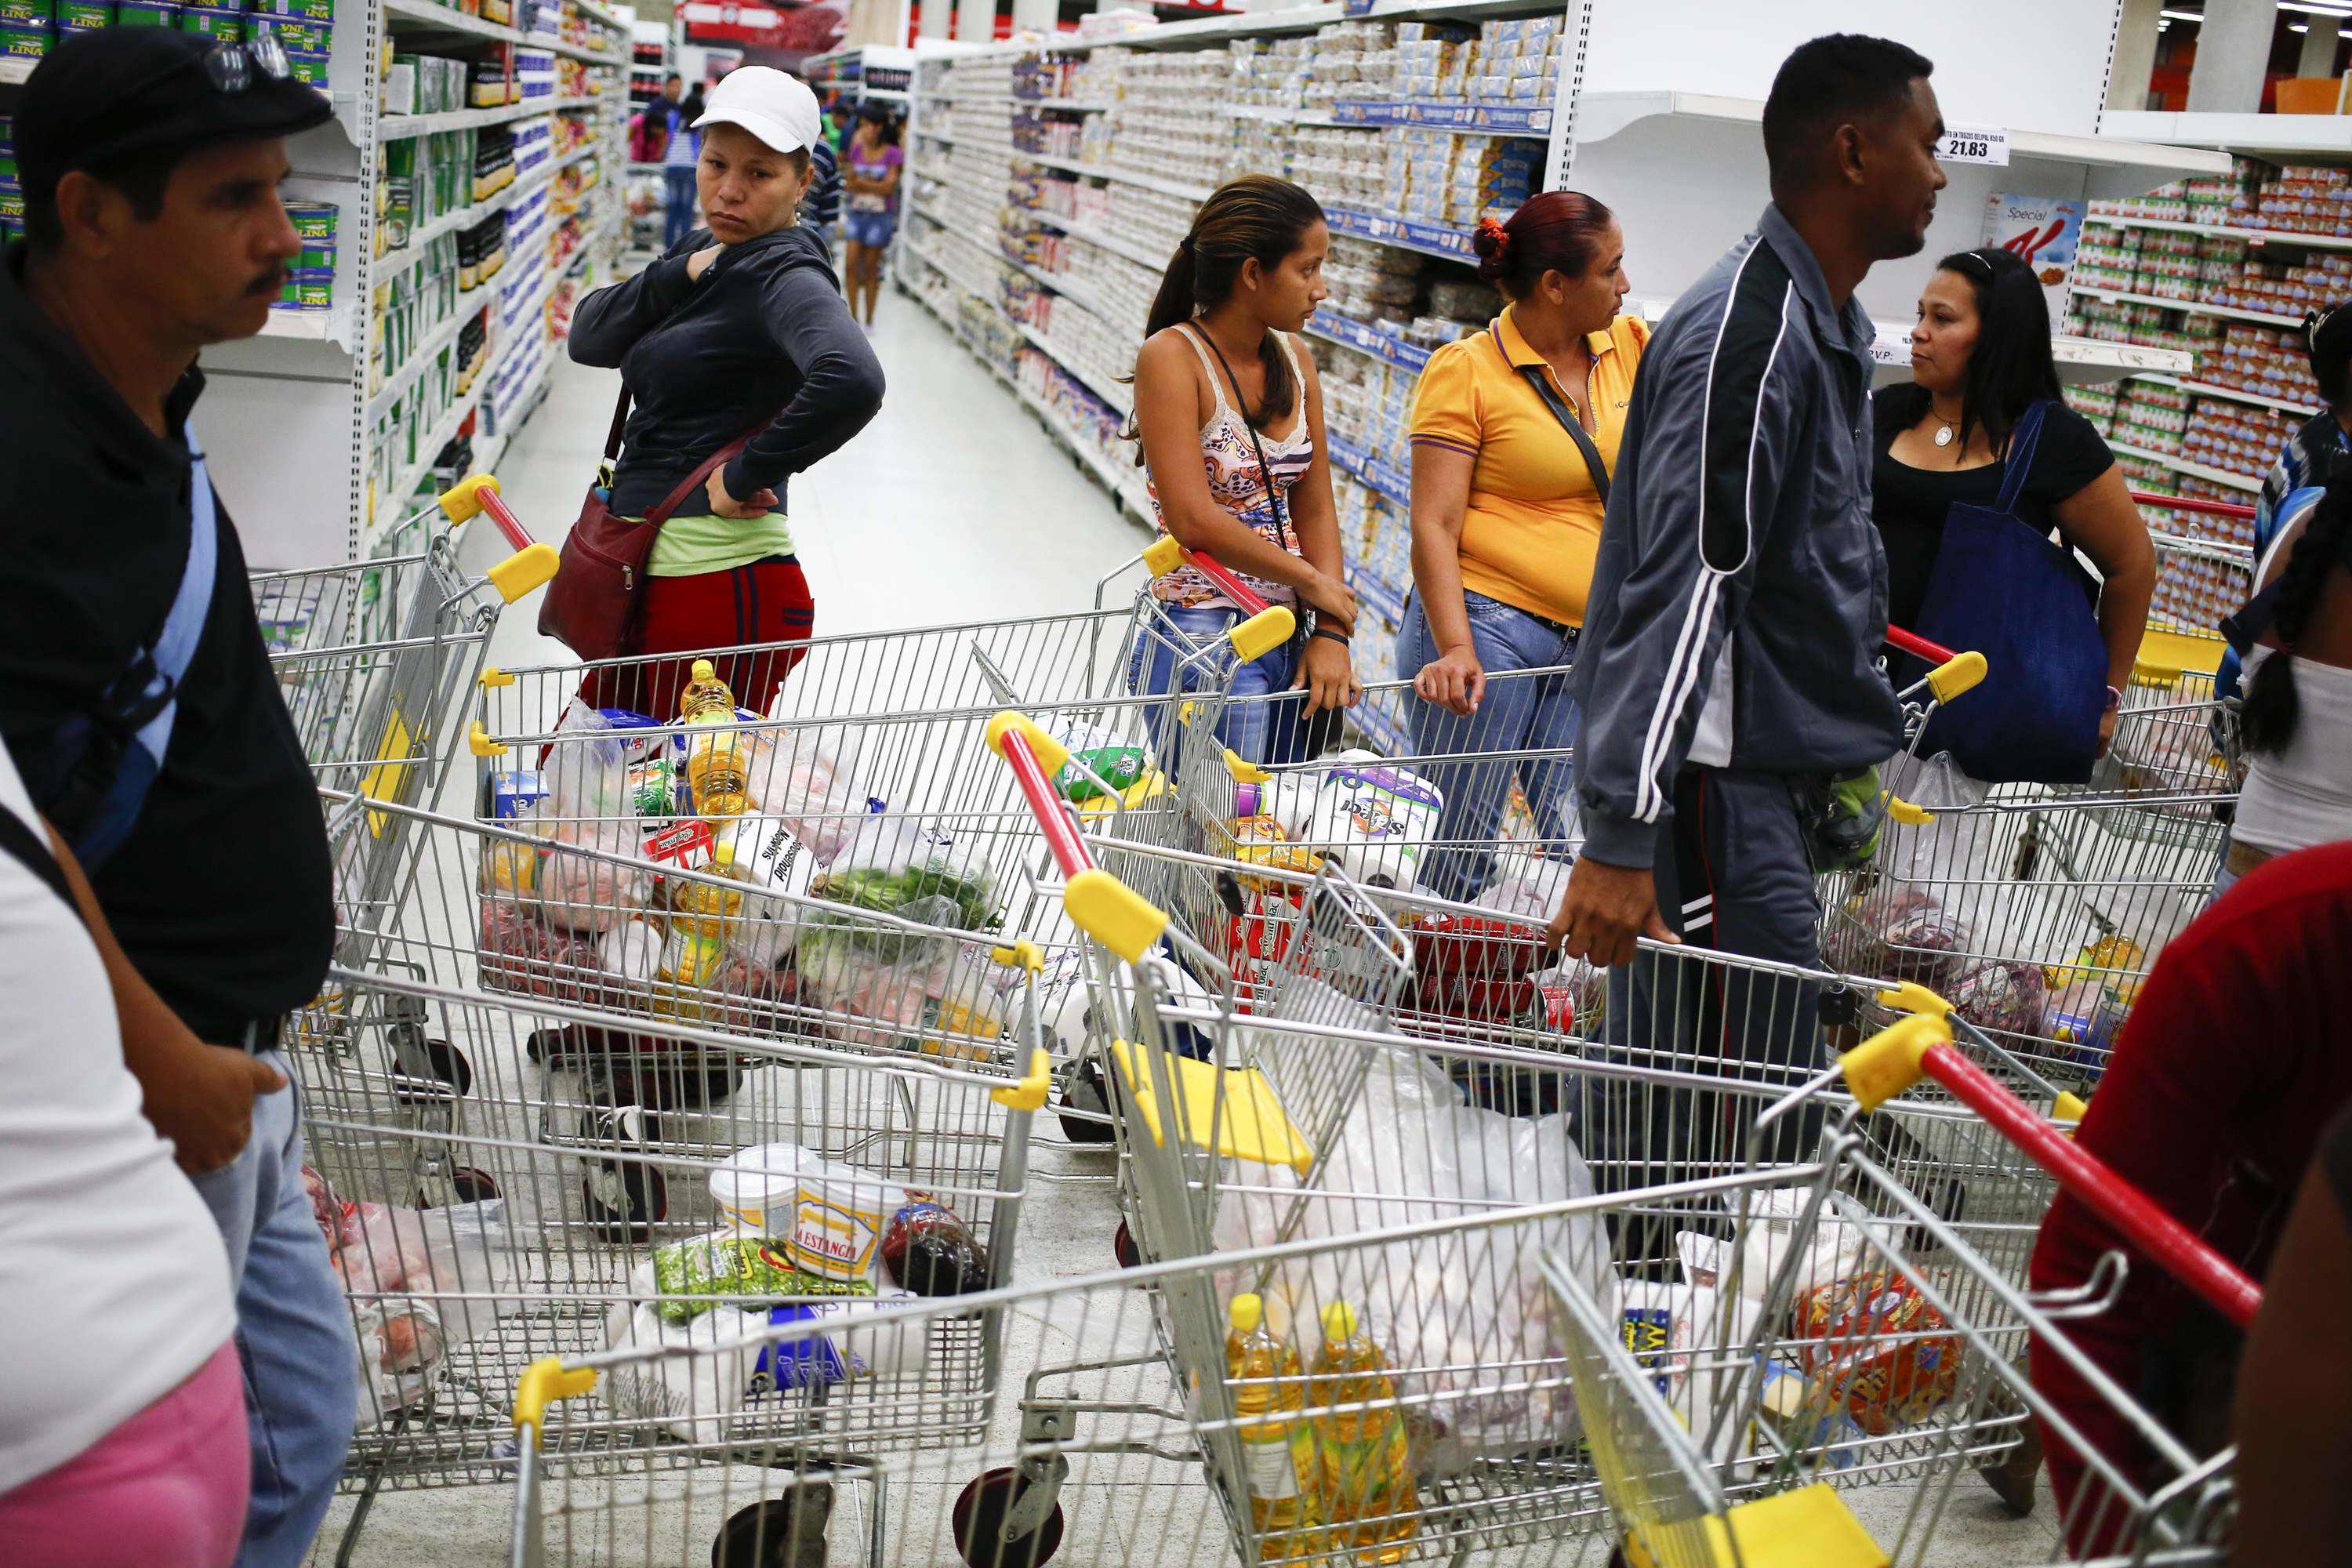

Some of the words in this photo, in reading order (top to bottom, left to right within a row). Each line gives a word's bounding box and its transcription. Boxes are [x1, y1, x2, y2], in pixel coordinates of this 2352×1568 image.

[305, 9, 329, 19] LINA
[71, 17, 105, 28] LINA
[8, 45, 43, 56] LINA
[1949, 140, 1987, 157] 21,83
[2007, 207, 2047, 221] Special
[804, 1232, 856, 1259] ESTANCIA
